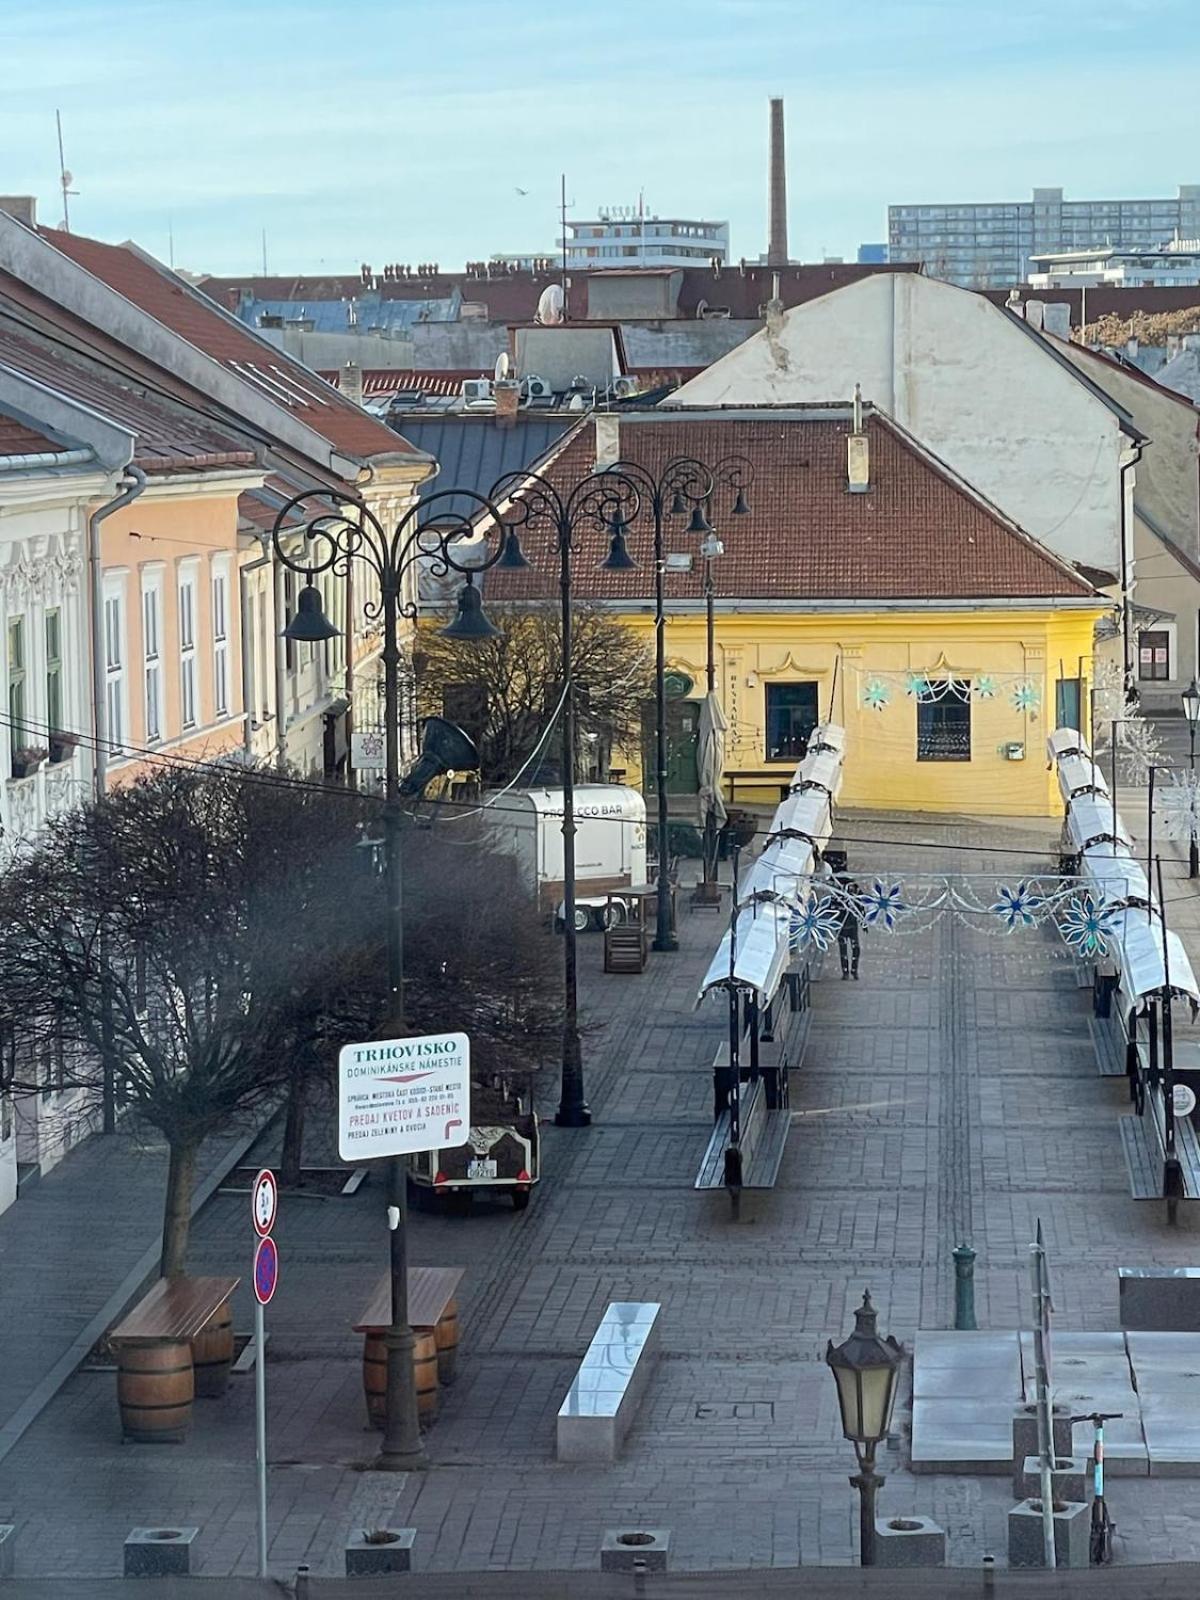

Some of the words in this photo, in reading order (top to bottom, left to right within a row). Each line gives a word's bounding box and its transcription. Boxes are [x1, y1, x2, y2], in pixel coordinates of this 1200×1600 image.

[601, 804, 623, 814] BAR
[353, 1041, 457, 1063] TRHOVISKO
[347, 1061, 415, 1078] DOMINIKÁNSKE
[419, 1056, 462, 1070] NÁMESTIE
[349, 1113, 379, 1127] PREDAJ
[383, 1109, 413, 1123] KVETOV
[417, 1108, 422, 1118] A
[347, 1129, 369, 1139] PREDAJ
